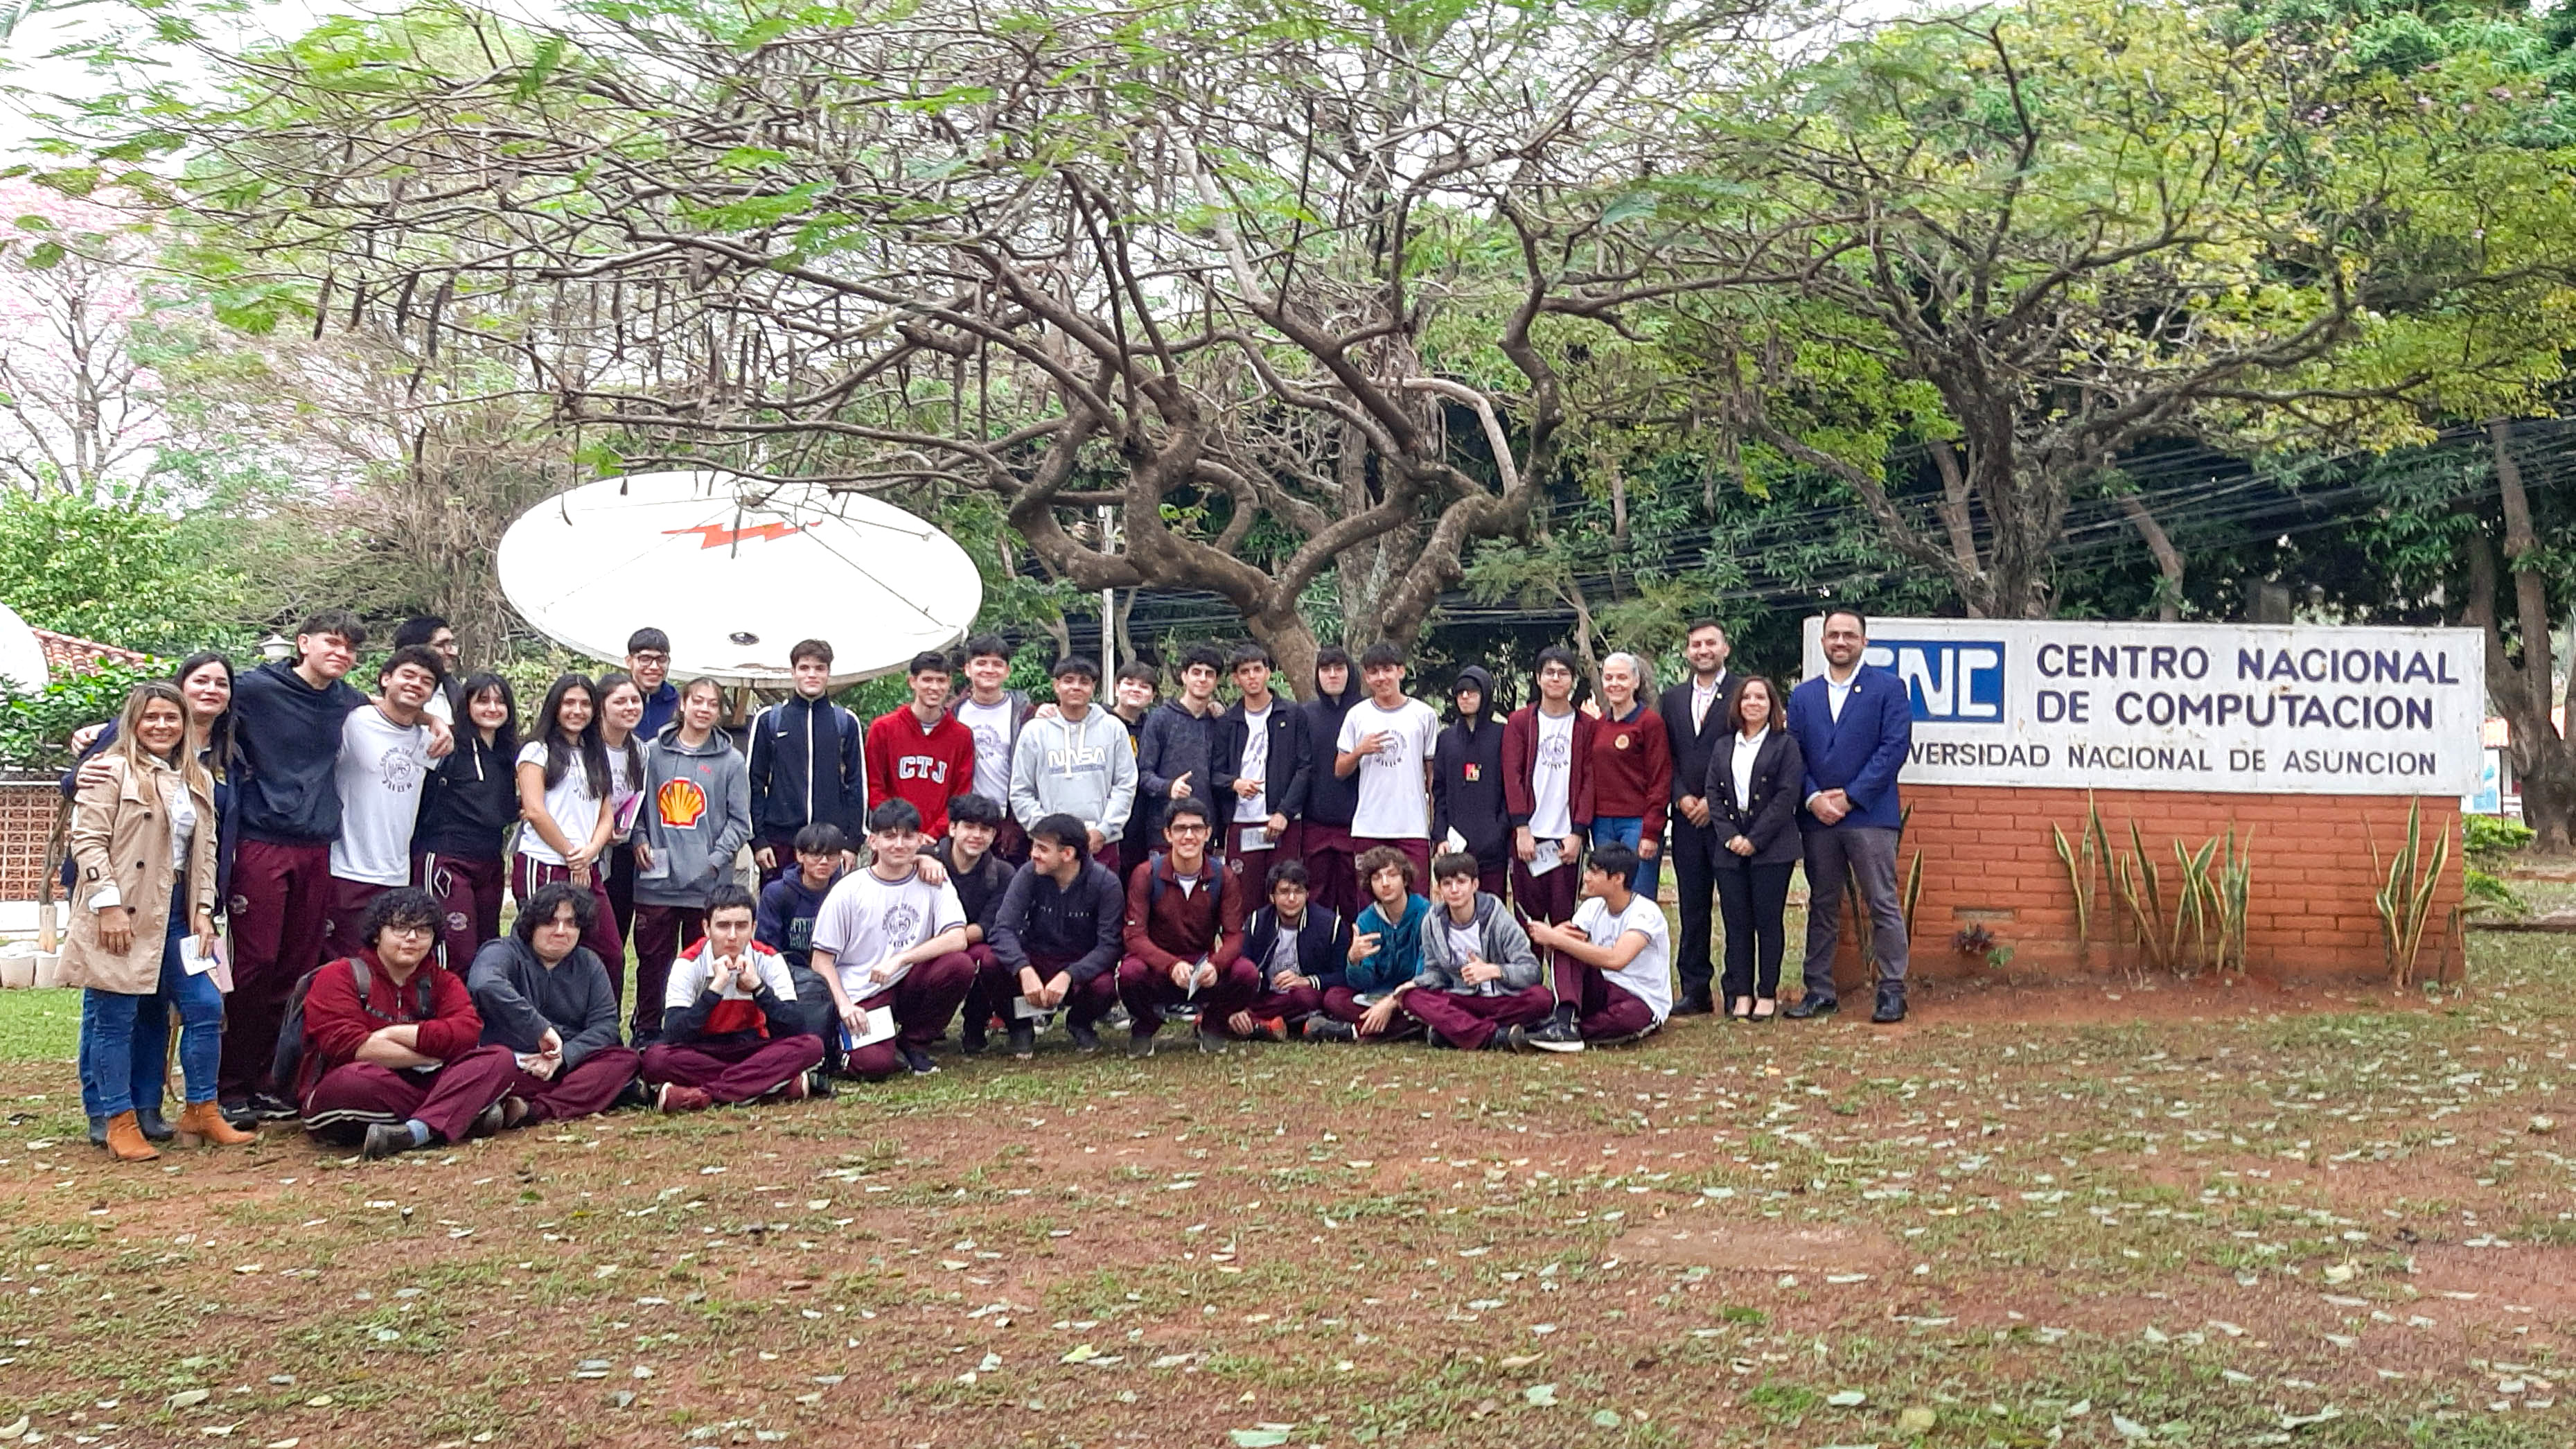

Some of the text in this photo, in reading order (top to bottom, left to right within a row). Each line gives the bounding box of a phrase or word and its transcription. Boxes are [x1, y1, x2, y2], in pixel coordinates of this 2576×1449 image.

[1864, 647, 1998, 717] NC
[2037, 643, 2460, 685] CENTRO NACIONAL
[2037, 690, 2433, 730] DE COMPUTACION
[899, 755, 947, 784] CTJ
[1910, 741, 2436, 776] VERSIDAD NACIONAL DE ASUNCION
